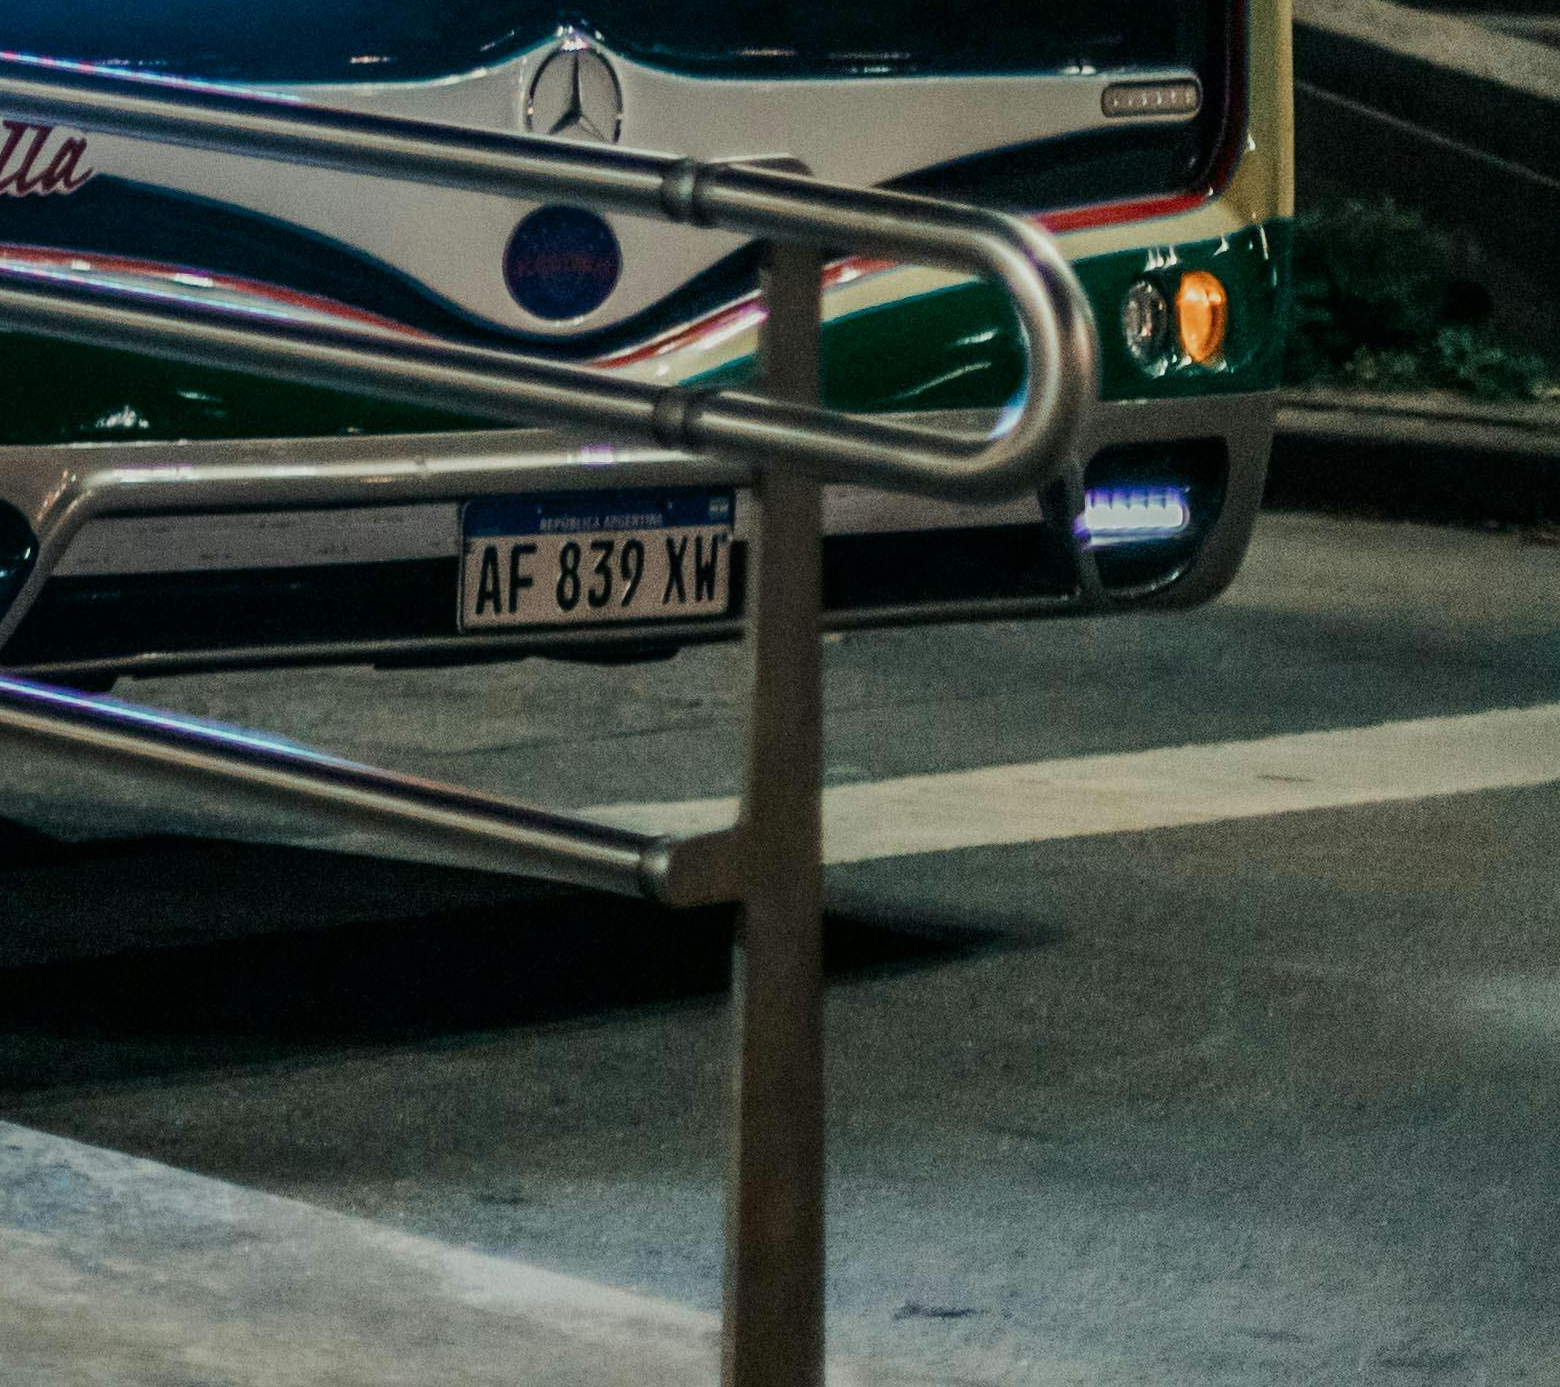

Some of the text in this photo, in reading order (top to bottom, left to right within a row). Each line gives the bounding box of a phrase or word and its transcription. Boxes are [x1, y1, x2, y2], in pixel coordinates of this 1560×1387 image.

[475, 533, 719, 615] AF 839 XW
